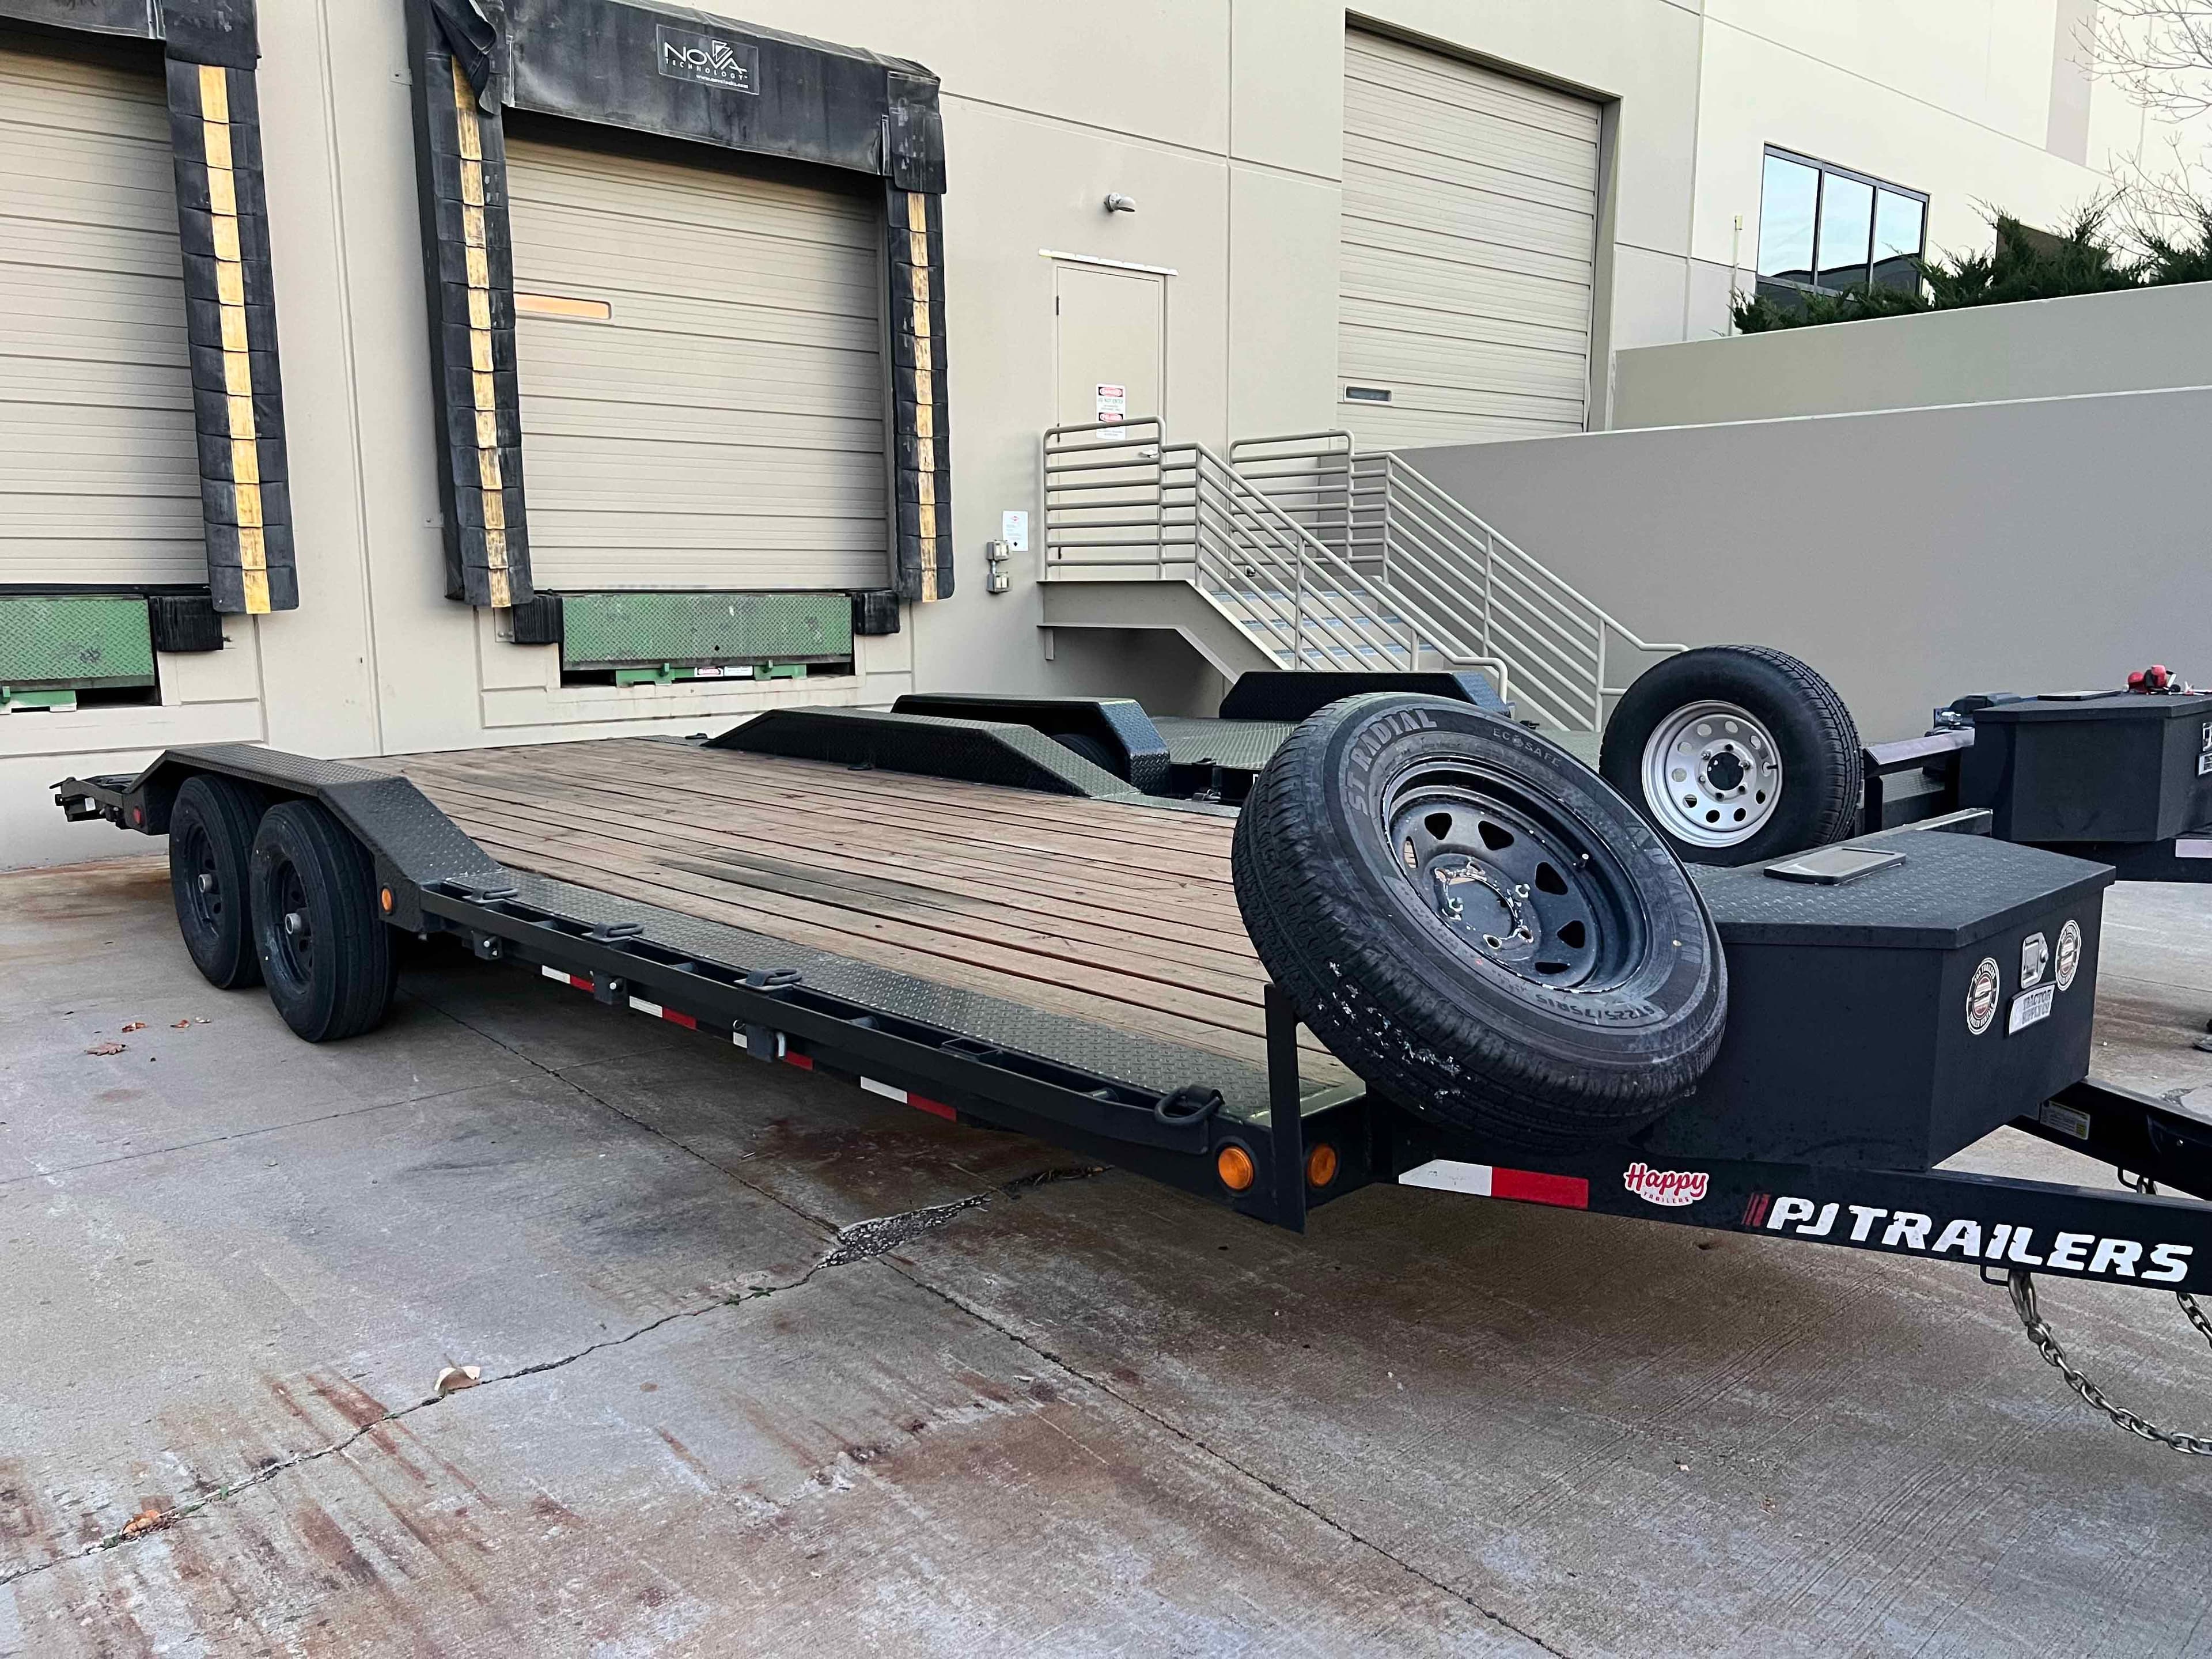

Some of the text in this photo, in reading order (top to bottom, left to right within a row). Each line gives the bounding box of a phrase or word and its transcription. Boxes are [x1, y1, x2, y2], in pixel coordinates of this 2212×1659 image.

[664, 42, 747, 74] NOVA
[665, 58, 743, 81] TECHNOLOGY
[1350, 708, 1438, 772] RADIAL
[1346, 771, 1369, 816] ST
[1627, 1164, 1706, 1198] Happy
[1643, 1191, 1690, 1204] TRAILERS
[1766, 1196, 2193, 1282] PJ TRAILERS
